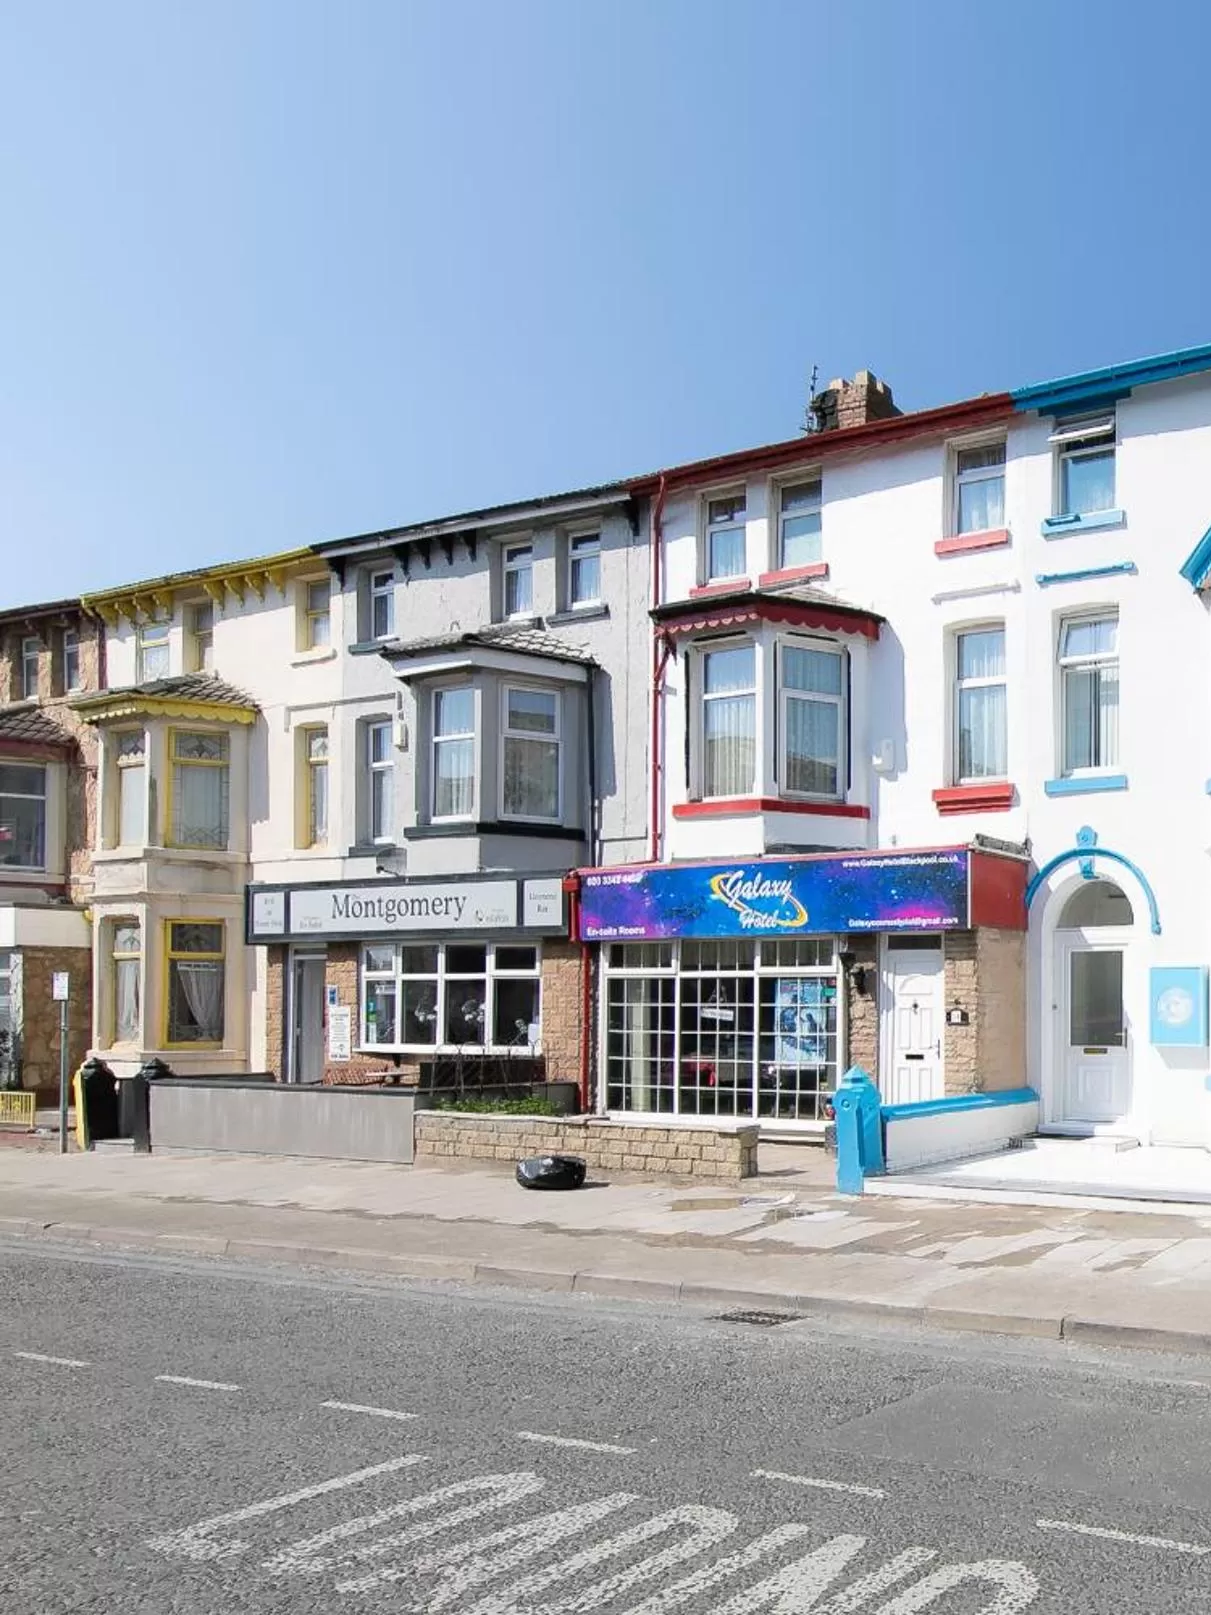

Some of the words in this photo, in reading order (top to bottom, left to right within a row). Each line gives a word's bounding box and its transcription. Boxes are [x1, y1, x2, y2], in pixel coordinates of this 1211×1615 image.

[725, 869, 792, 908] Galaxy
[332, 894, 467, 923] Montgomery
[740, 909, 780, 929] Hotel
